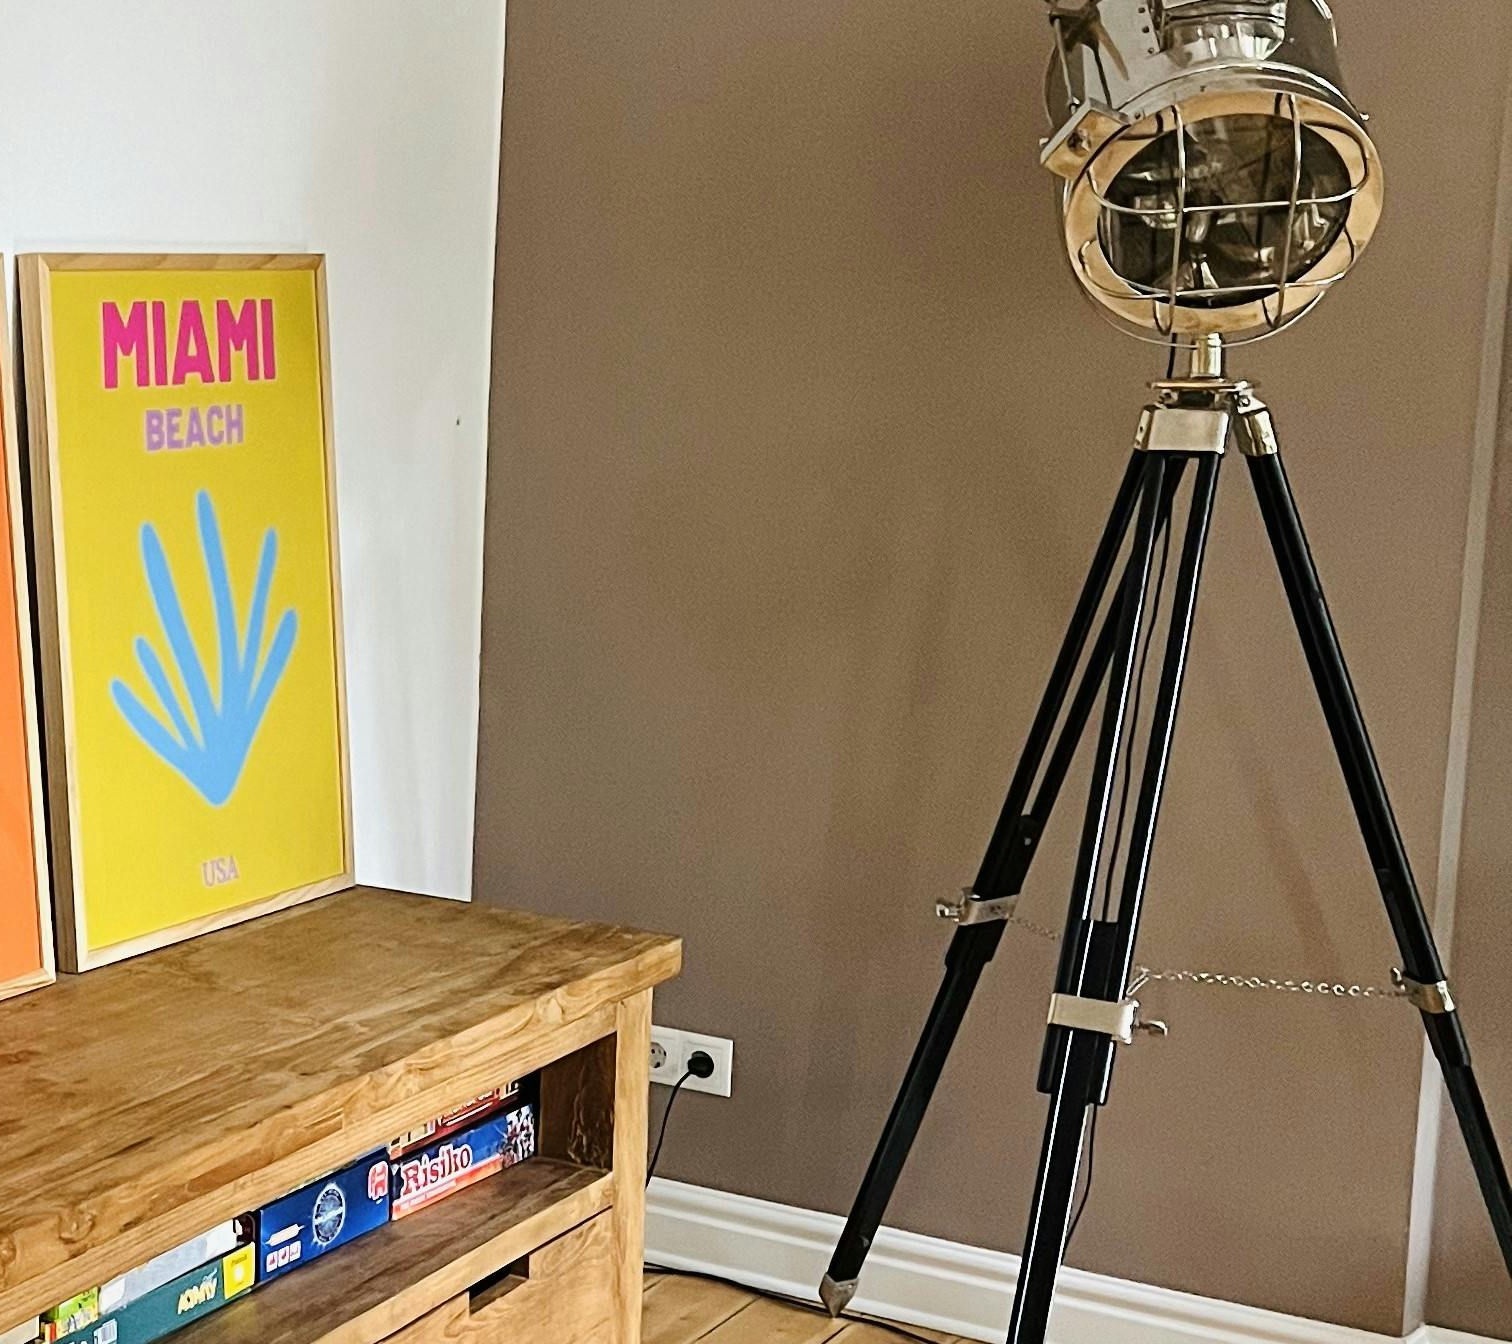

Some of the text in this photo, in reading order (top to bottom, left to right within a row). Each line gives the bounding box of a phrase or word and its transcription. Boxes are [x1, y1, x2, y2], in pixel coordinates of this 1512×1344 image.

[101, 298, 277, 390] MIAMI
[142, 403, 246, 453] BEACH
[201, 855, 240, 888] USA
[402, 1144, 472, 1197] Risiko
